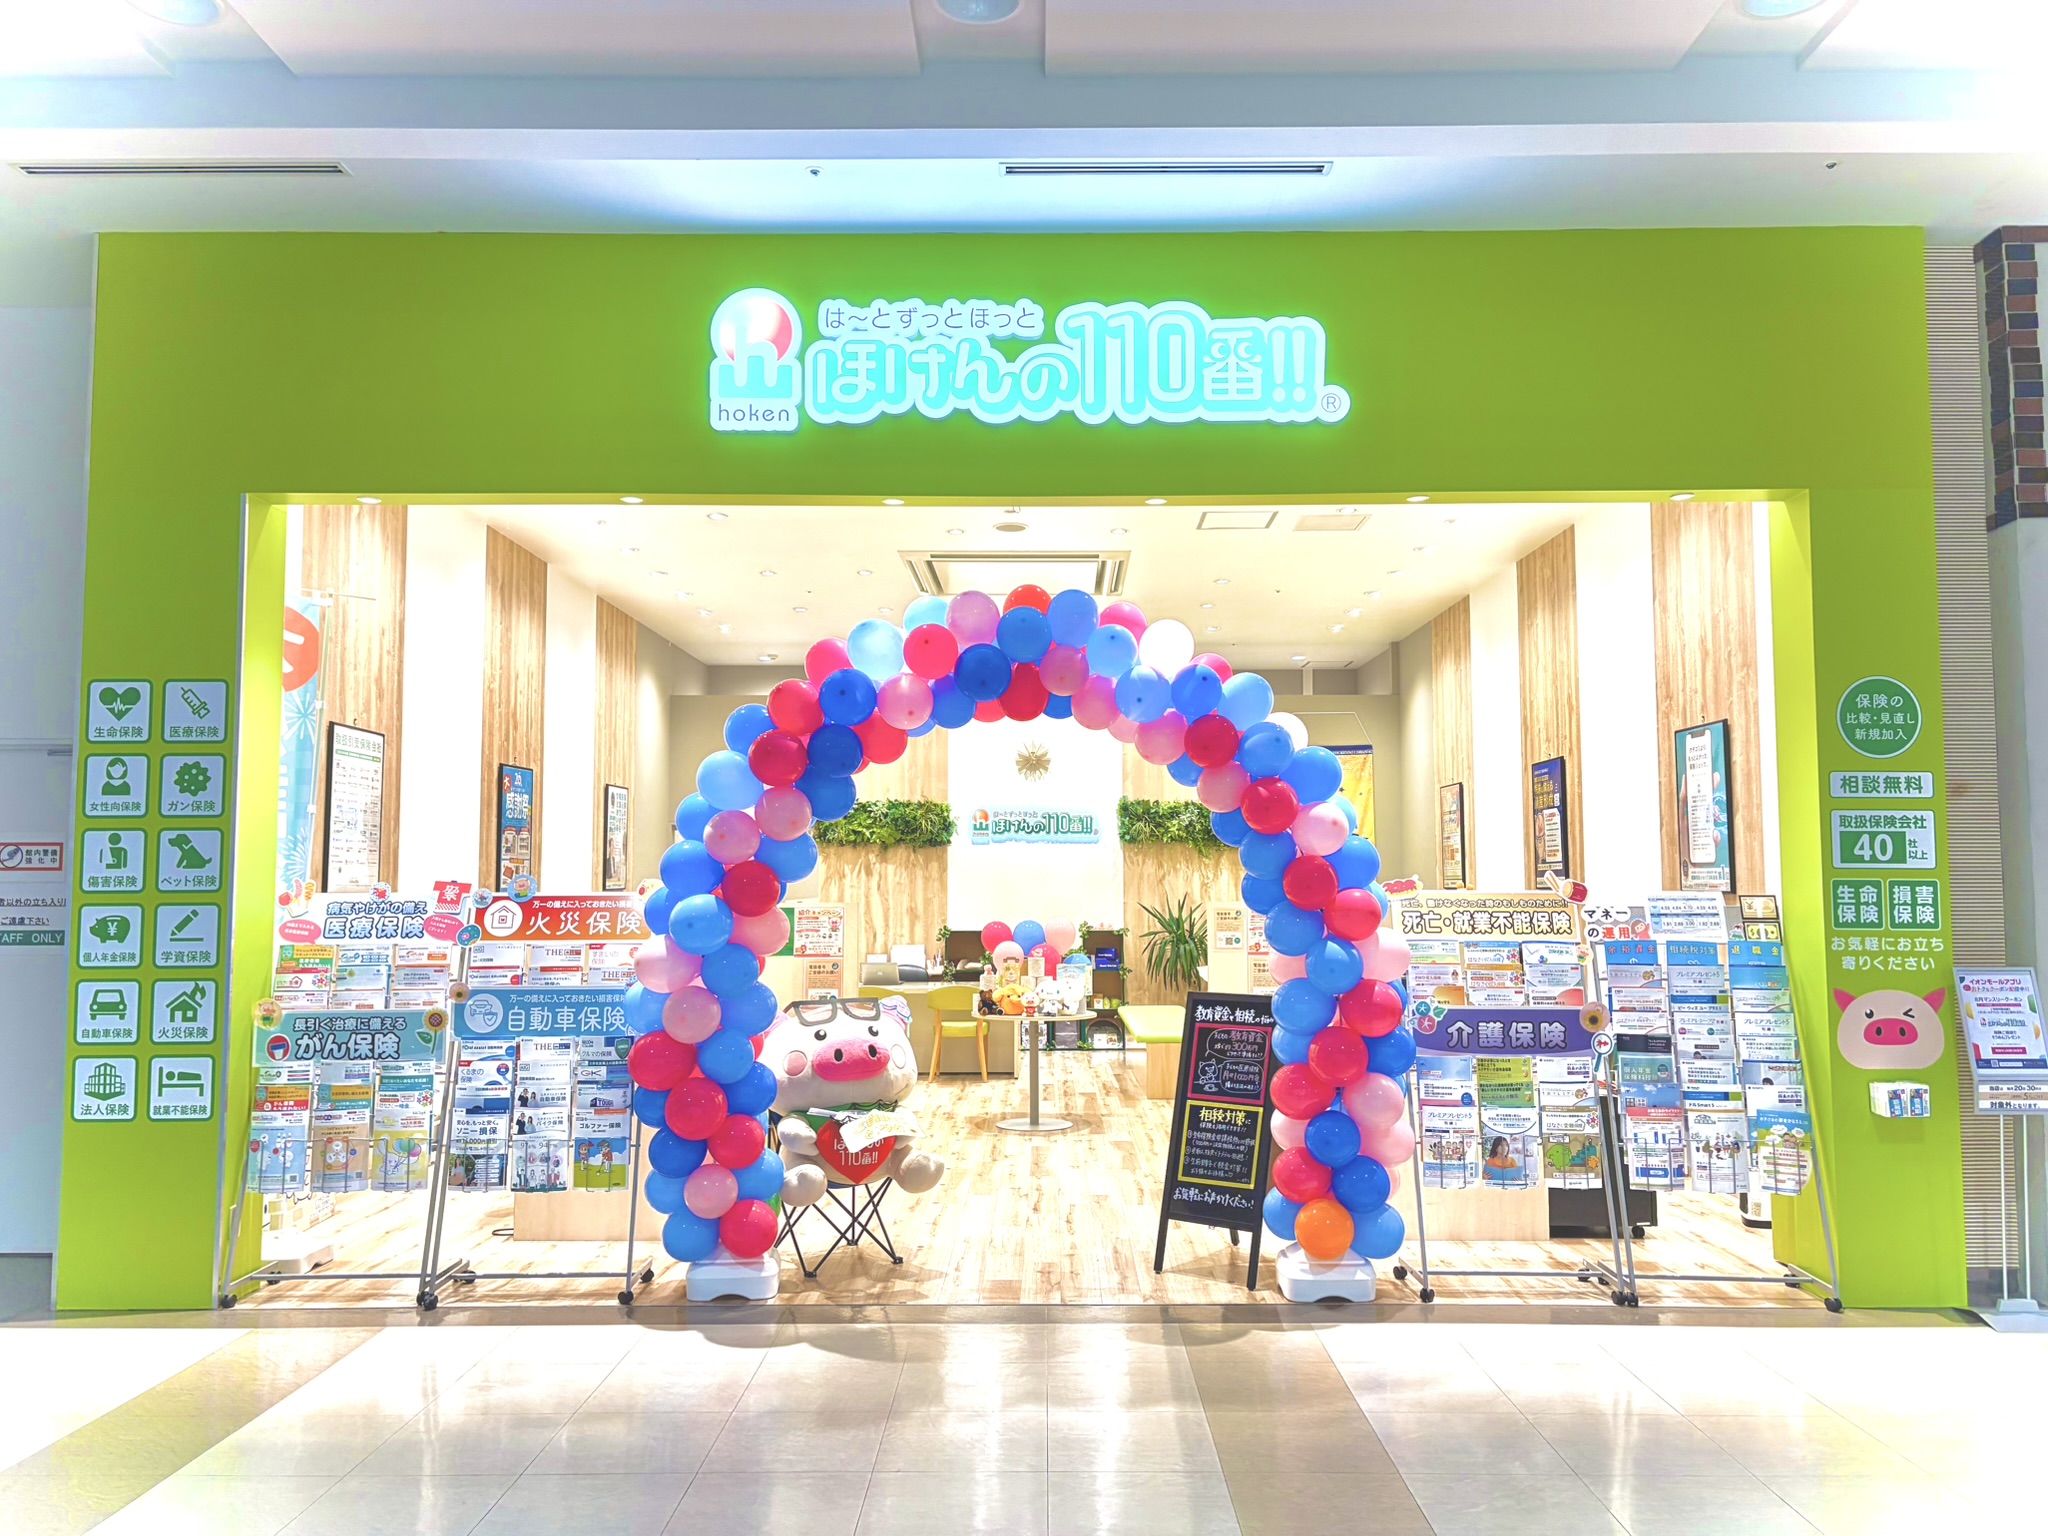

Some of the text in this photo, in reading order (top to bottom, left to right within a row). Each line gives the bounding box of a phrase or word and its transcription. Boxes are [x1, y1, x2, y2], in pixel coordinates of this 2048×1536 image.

[718, 404, 791, 424] hoken
[1855, 693, 1904, 709] 保険の
[1845, 712, 1915, 725] 比較・見直し
[94, 726, 143, 738] 生命保険
[169, 726, 219, 738] 医療保険
[1854, 729, 1907, 741] 新規加入
[1840, 775, 1923, 795] 相談無料
[90, 801, 141, 812] 女性向保険
[167, 800, 216, 812] ガン保険
[992, 812, 1093, 834] ほけんの110番!!
[1838, 814, 1927, 829] 取扱保険会社
[1853, 833, 1894, 862] 40
[1908, 838, 1918, 849] 社
[25, 849, 58, 857] 館内警備
[1908, 850, 1928, 860] 以上
[87, 876, 138, 888] 傷害保険
[161, 875, 217, 887] ペット保険
[442, 885, 460, 901] 祭
[1837, 885, 1878, 904] 生命
[1893, 885, 1934, 904] 損害
[327, 901, 428, 915] 病気やけがの備え
[1401, 898, 1569, 909] 死亡、働けなくなった時のもしものために!!
[1584, 908, 1628, 920] マネー
[1837, 905, 1879, 924] 保険
[1893, 905, 1935, 924] 保険
[1, 916, 50, 926] ご遠慮下さい
[526, 911, 642, 936] 火災保険
[1402, 910, 1573, 935] 死亡・就業不能保険
[324, 917, 424, 939] 医療保険
[1587, 926, 1631, 939] の運用
[31, 933, 63, 943] ONLY
[1731, 944, 1780, 956] 退職金
[1831, 937, 1944, 952] お気軽にお立ち
[83, 952, 136, 963] 個人年金保険
[161, 951, 211, 963] 学資保険
[545, 948, 564, 956] THE
[1841, 956, 1935, 971] 寄りください
[601, 970, 620, 978] THE
[294, 1016, 407, 1032] 長引く治療に備える
[507, 1005, 626, 1032] 自動車保険
[81, 1028, 133, 1039] 自動車保険
[158, 1027, 208, 1039] 火災保険
[1446, 1020, 1568, 1049] 介護保険
[295, 1032, 401, 1060] がん保険
[533, 1043, 552, 1051] THE
[1623, 1066, 1652, 1074] 個人年金
[80, 1104, 129, 1116] 法人保険
[153, 1105, 208, 1116] 就業不能保険
[1199, 1107, 1251, 1126] 相続対策に
[456, 1127, 498, 1136] ソニー損保
[839, 1150, 879, 1166] 110番!!
